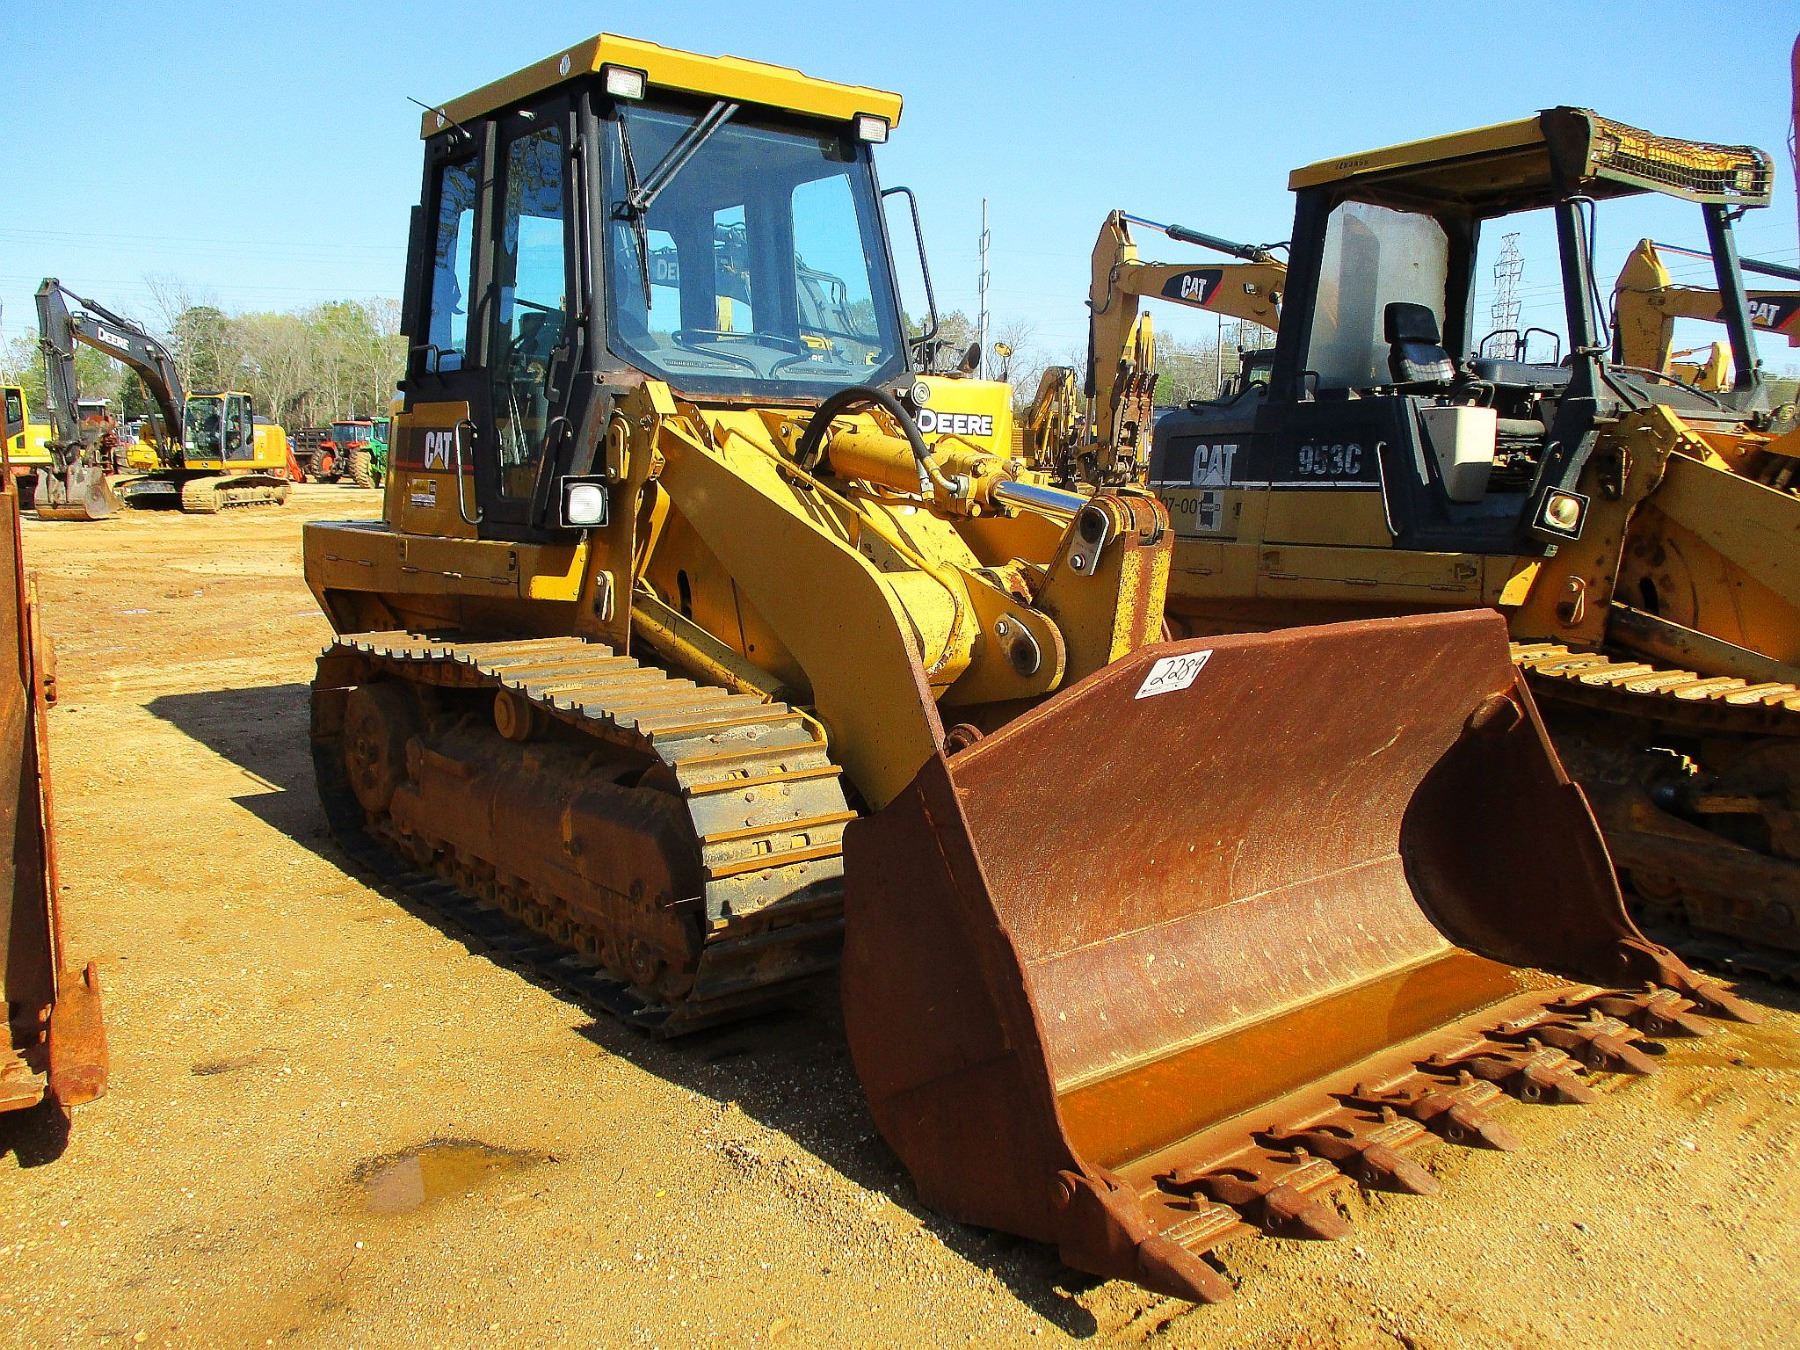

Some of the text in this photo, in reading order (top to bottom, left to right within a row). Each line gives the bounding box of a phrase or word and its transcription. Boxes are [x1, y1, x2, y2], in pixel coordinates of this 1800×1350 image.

[1180, 275, 1208, 302] CAT
[1747, 300, 1781, 327] CAT
[97, 325, 131, 351] DEERE
[917, 408, 993, 436] DEERE
[424, 431, 453, 470] CAT
[1298, 443, 1362, 475] 953C
[1192, 444, 1238, 487] CAT
[1149, 655, 1207, 686] 2289
